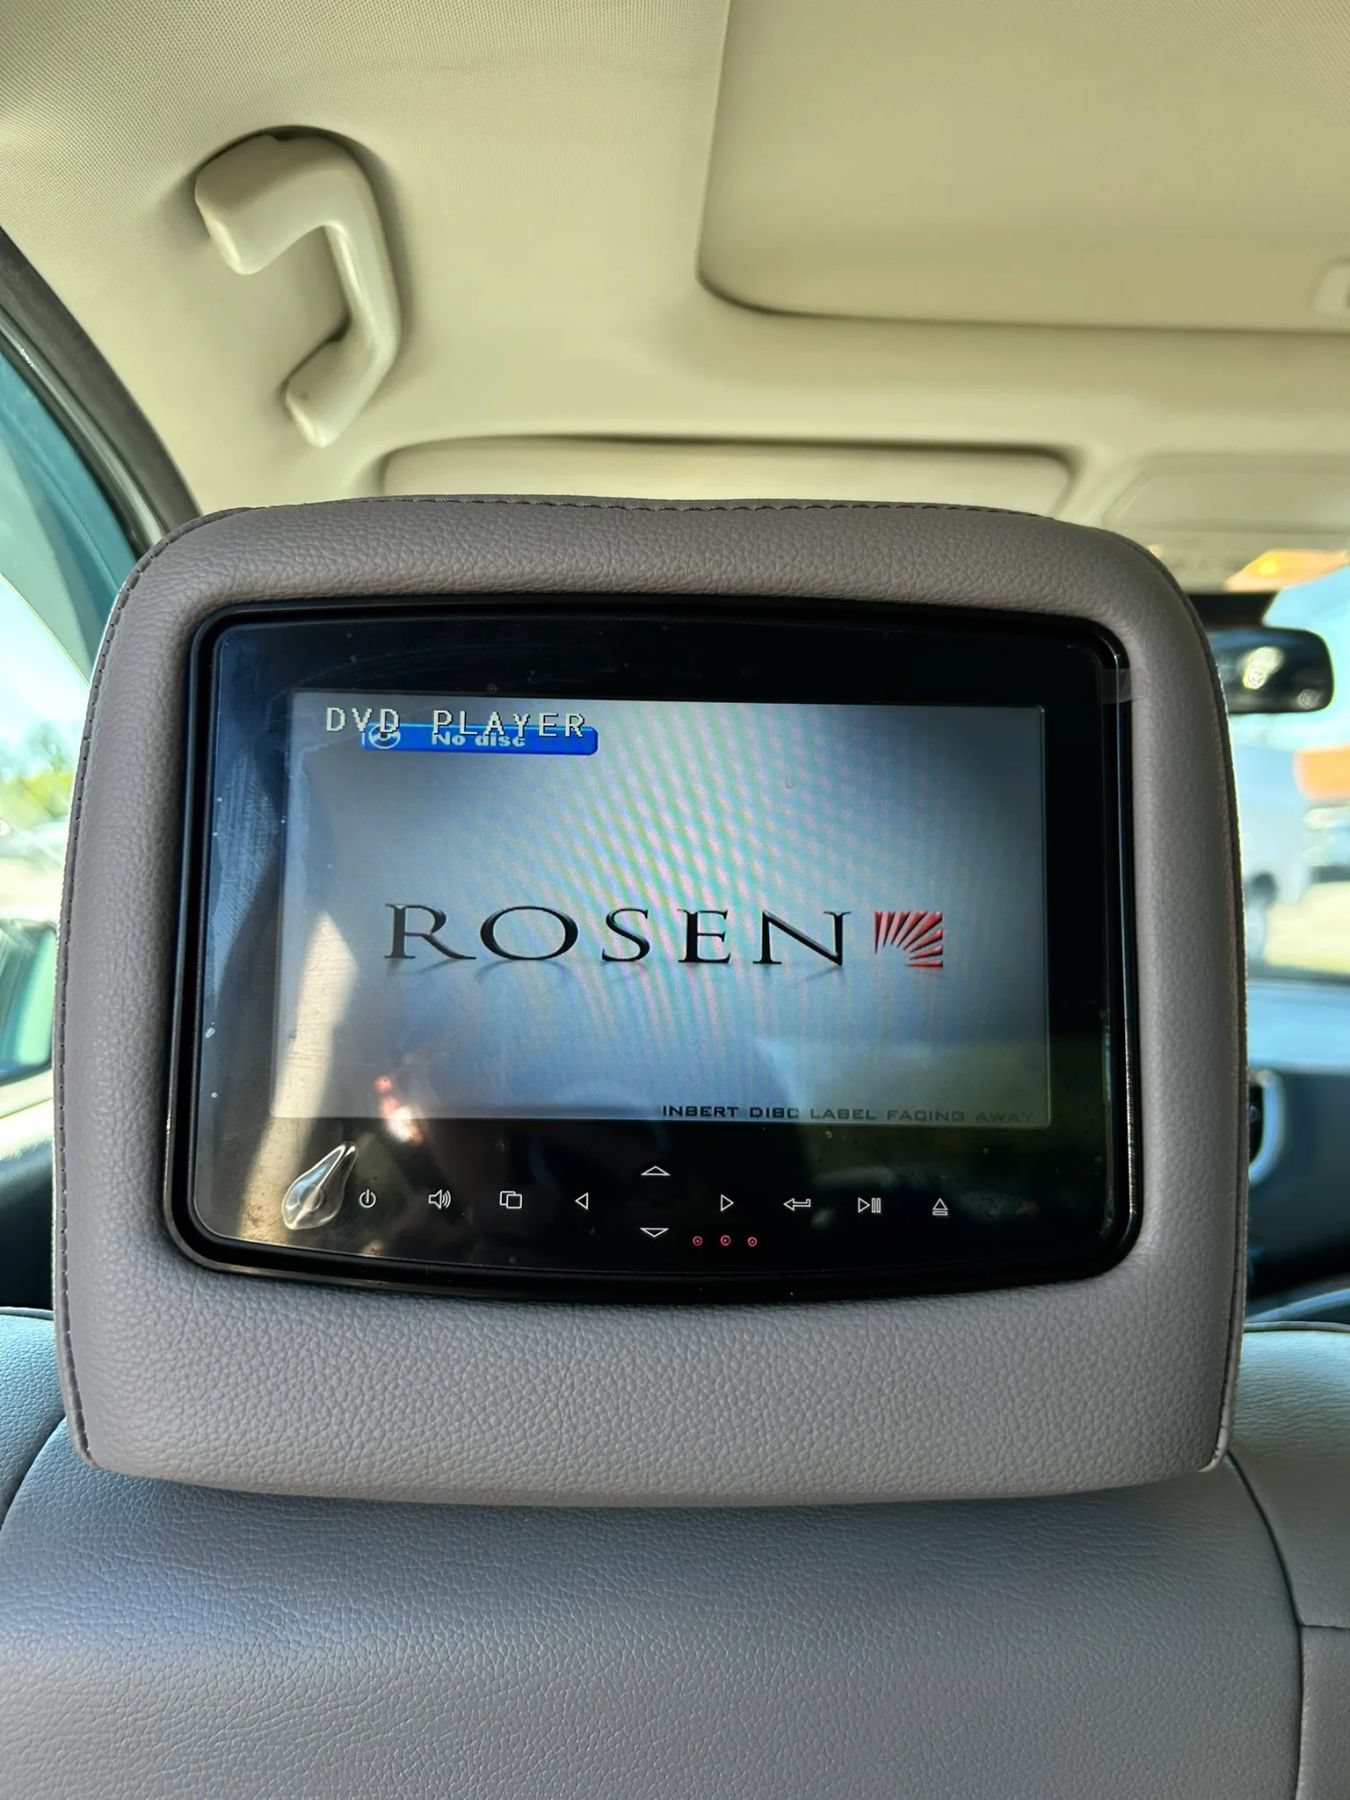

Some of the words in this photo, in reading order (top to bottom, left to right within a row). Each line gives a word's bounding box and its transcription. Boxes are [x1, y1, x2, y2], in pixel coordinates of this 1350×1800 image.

[326, 706, 400, 734] DVD
[432, 709, 586, 738] PLAYER
[431, 732, 466, 747] No
[383, 903, 851, 967] ROSEN
[662, 1104, 739, 1118] INSERT
[749, 1106, 799, 1119] DISC
[810, 1108, 877, 1121] LABEL
[887, 1109, 966, 1123] FACING
[975, 1111, 1034, 1124] AWAY
